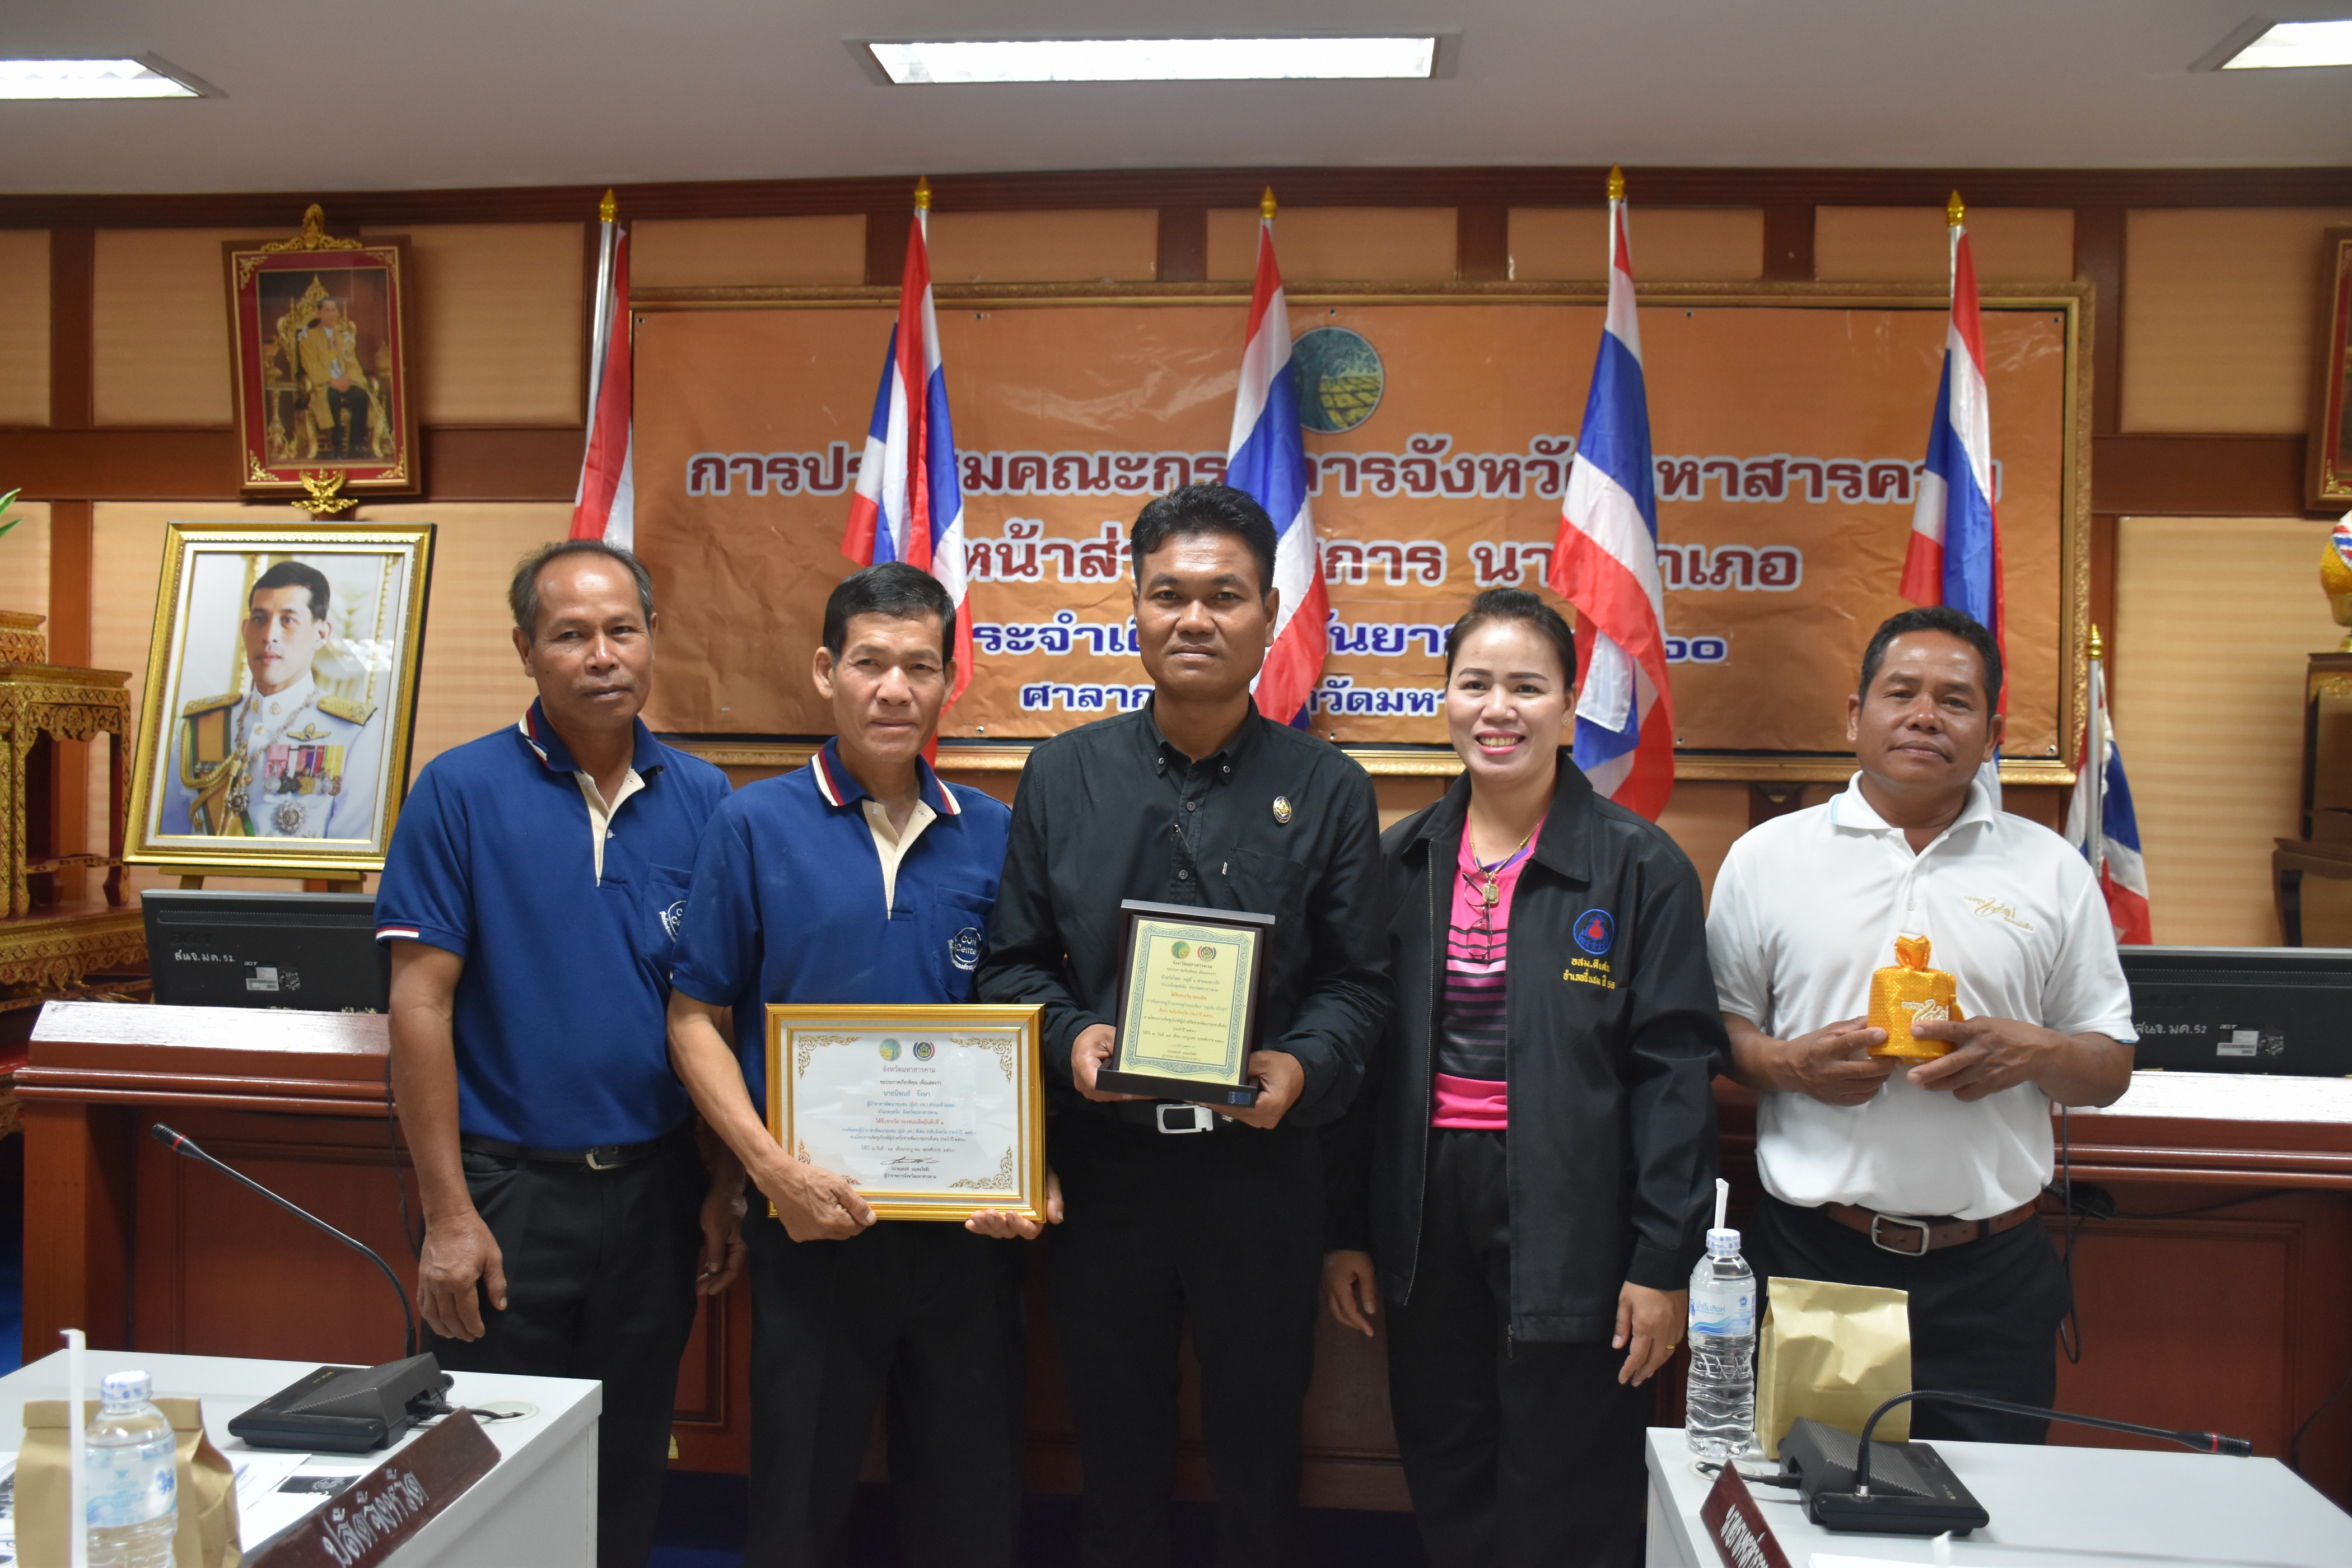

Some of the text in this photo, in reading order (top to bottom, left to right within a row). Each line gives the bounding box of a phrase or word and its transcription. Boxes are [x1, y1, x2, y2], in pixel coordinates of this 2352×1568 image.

[322, 1468, 430, 1568] ปลัดจังหวัด
